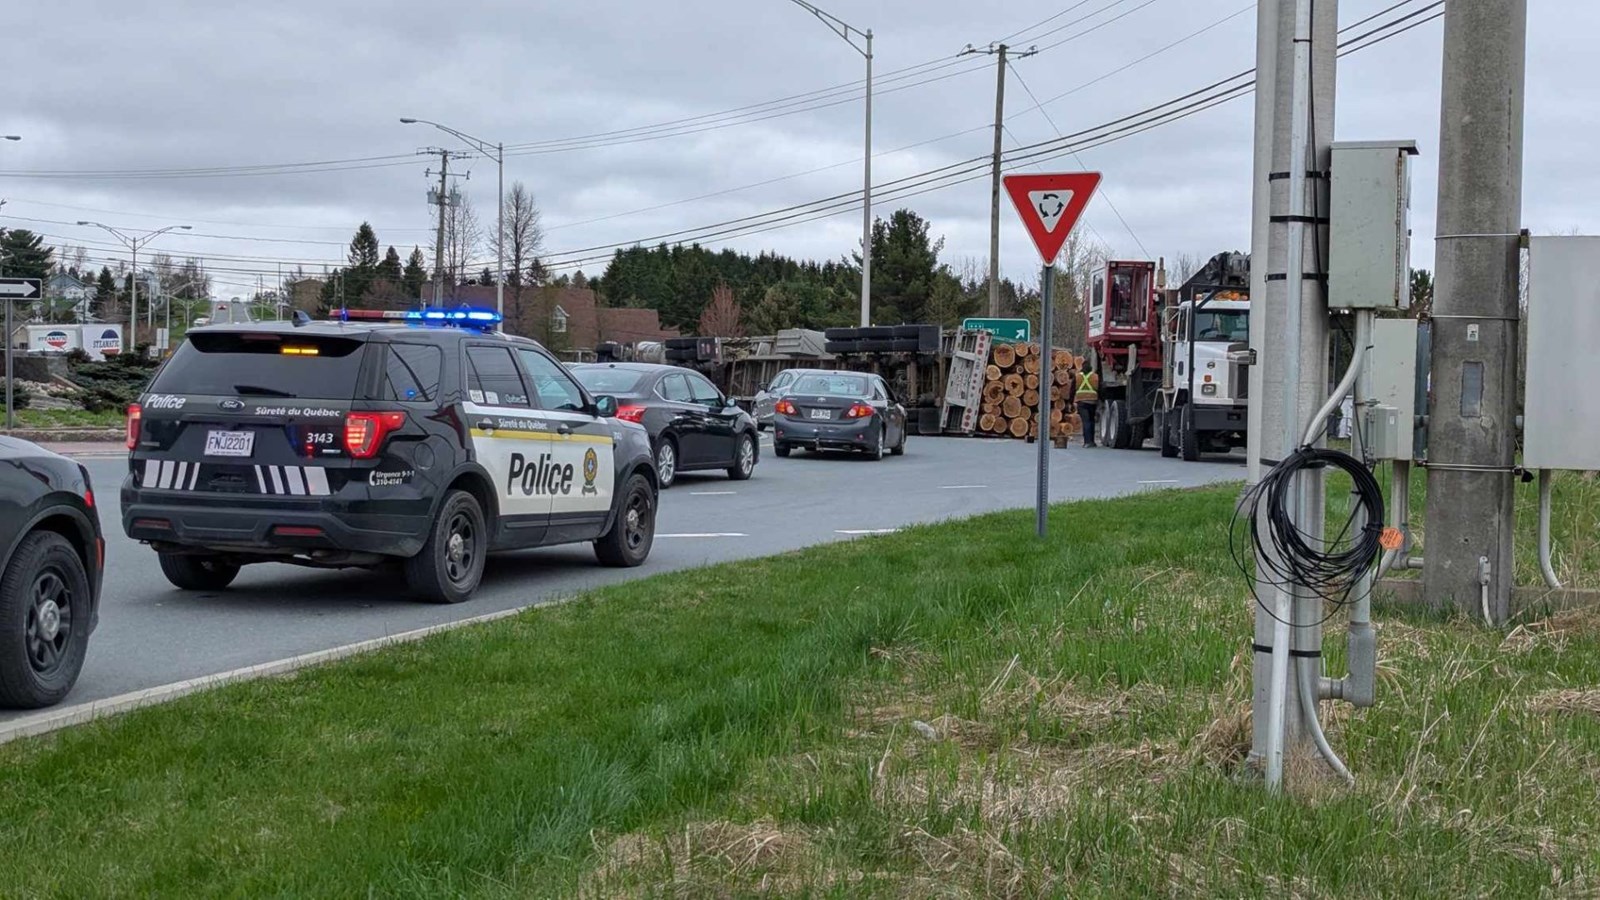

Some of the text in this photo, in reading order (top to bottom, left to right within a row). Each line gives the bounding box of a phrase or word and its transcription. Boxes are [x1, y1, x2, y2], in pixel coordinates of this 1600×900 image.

[145, 394, 186, 409] Police
[222, 400, 238, 409] Ford
[254, 406, 341, 417] Sûreté du Québec
[498, 418, 548, 431] Sûreté du Québec
[306, 432, 334, 443] 3143
[208, 437, 251, 450] FNJ2201
[402, 470, 415, 478] 9-1-1
[507, 452, 574, 496] Police
[376, 478, 403, 486] 310-4141
